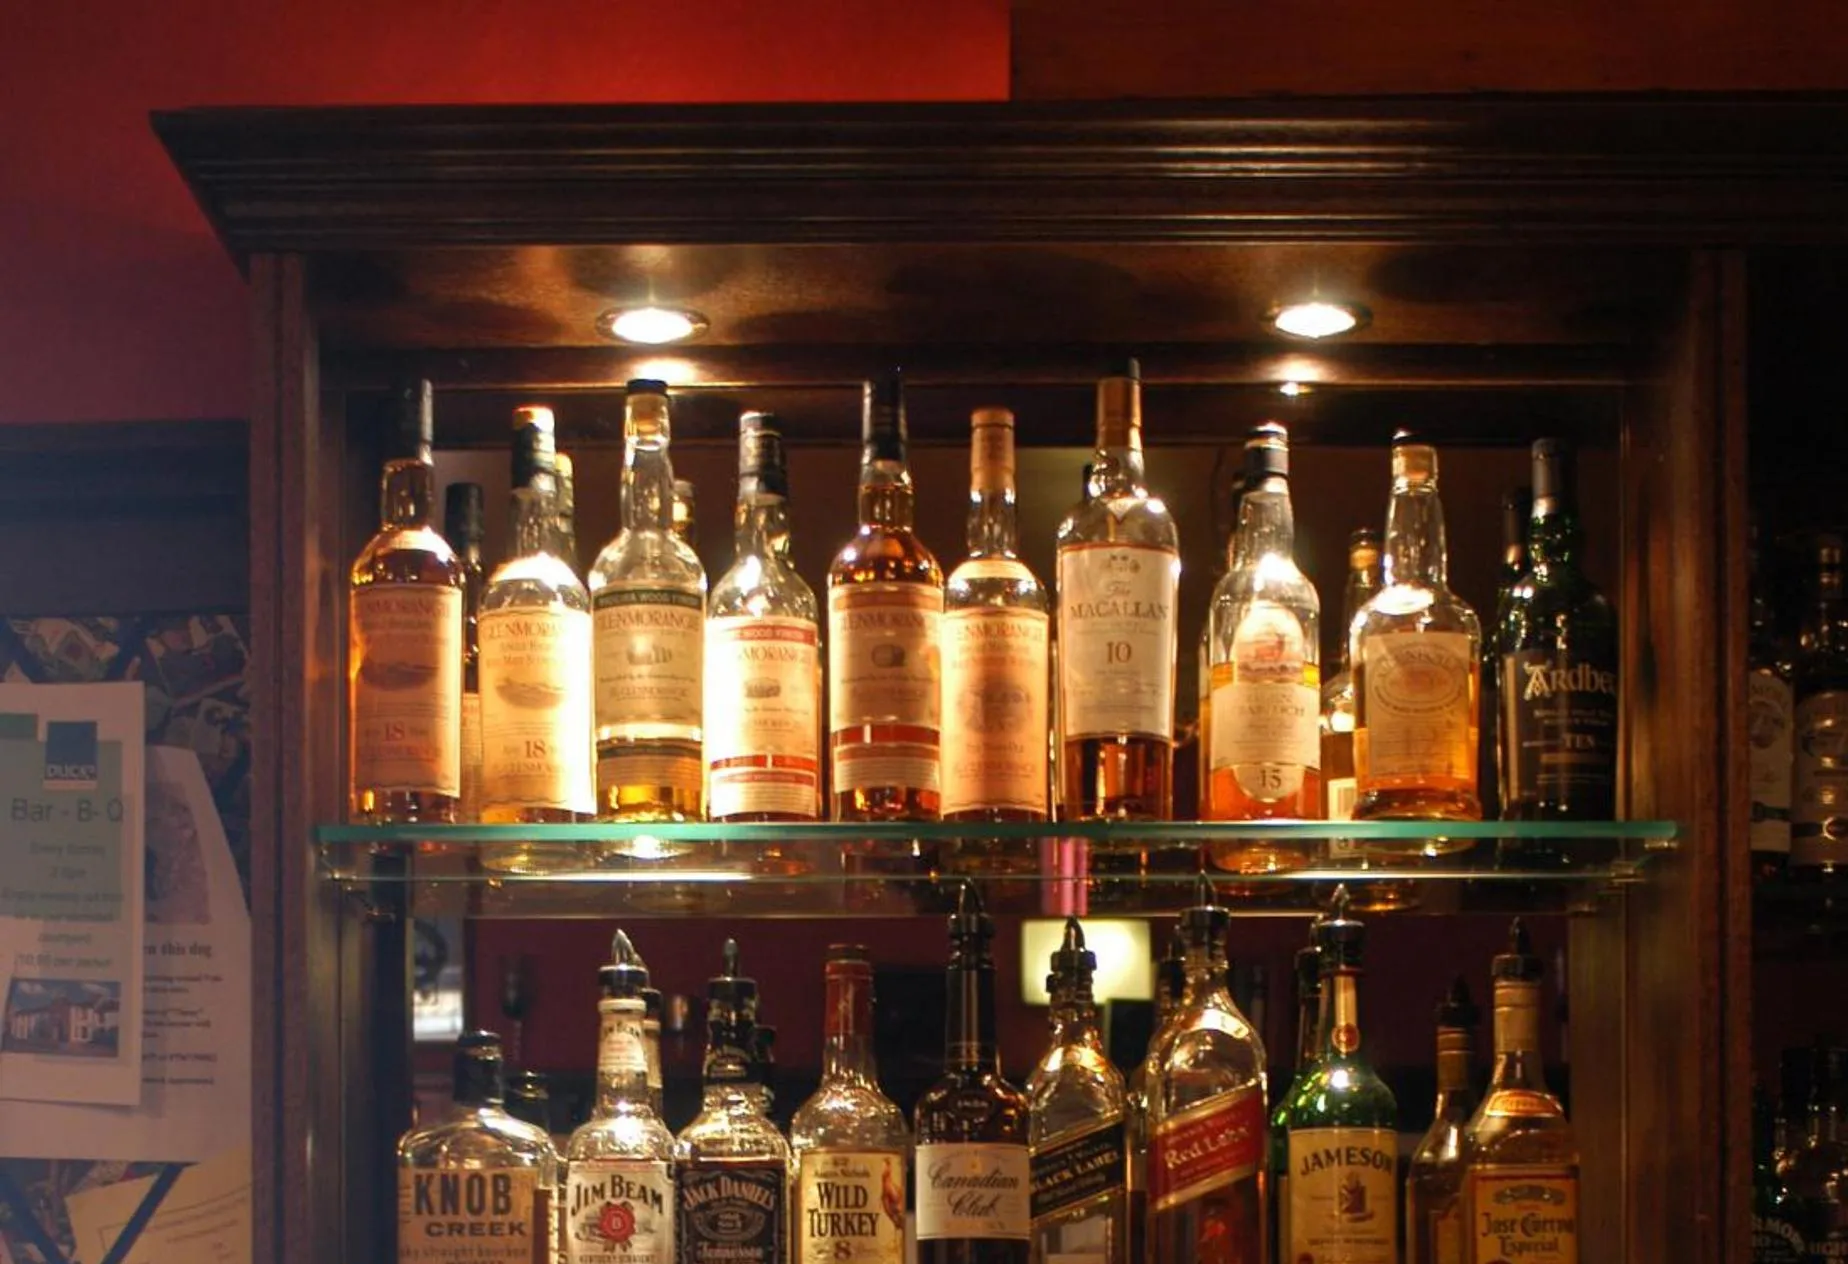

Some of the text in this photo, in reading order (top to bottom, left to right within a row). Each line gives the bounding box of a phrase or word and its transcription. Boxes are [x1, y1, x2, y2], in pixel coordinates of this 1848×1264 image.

[1070, 600, 1167, 620] MACALLAN
[1106, 640, 1134, 665] 10
[383, 723, 405, 742] 18
[525, 739, 547, 760] 18
[1259, 768, 1283, 789] 15
[11, 798, 53, 823] Bar
[1164, 1140, 1205, 1171] Red
[1300, 1146, 1392, 1176] JAMESON
[928, 1161, 1021, 1191] Canadian
[414, 1173, 513, 1216] KNOB
[571, 1174, 664, 1217] JIM BEAM
[682, 1181, 720, 1211] JACK
[817, 1181, 869, 1210] WILD
[947, 1189, 1002, 1218] Club
[425, 1221, 527, 1238] CREEK
[808, 1208, 881, 1238] TURKEY
[1481, 1212, 1575, 1238] Jose Cuervo
[833, 1240, 852, 1261] 8
